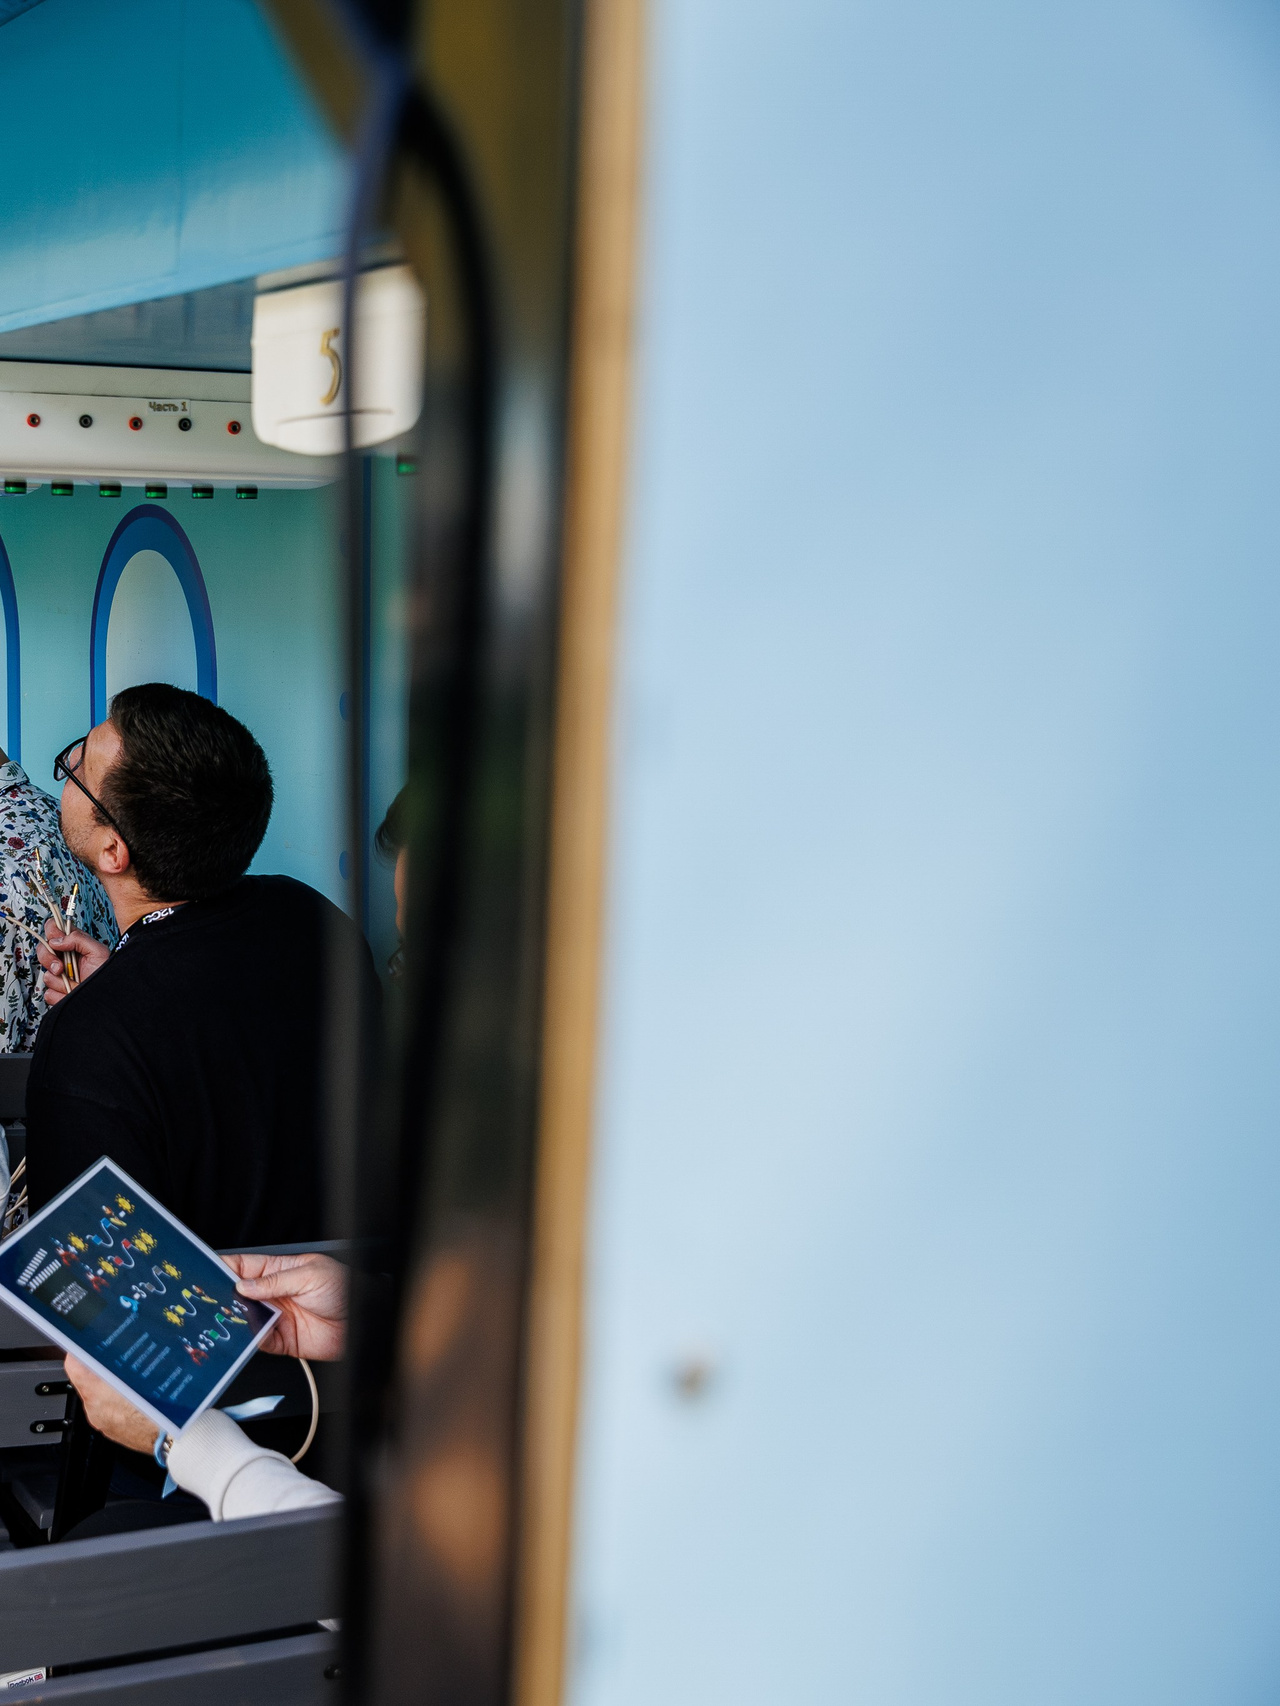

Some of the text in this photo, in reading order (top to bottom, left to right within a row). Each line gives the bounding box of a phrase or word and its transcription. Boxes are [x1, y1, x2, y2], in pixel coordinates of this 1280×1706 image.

[320, 328, 342, 405] 5
[149, 401, 188, 412] Часть 1
